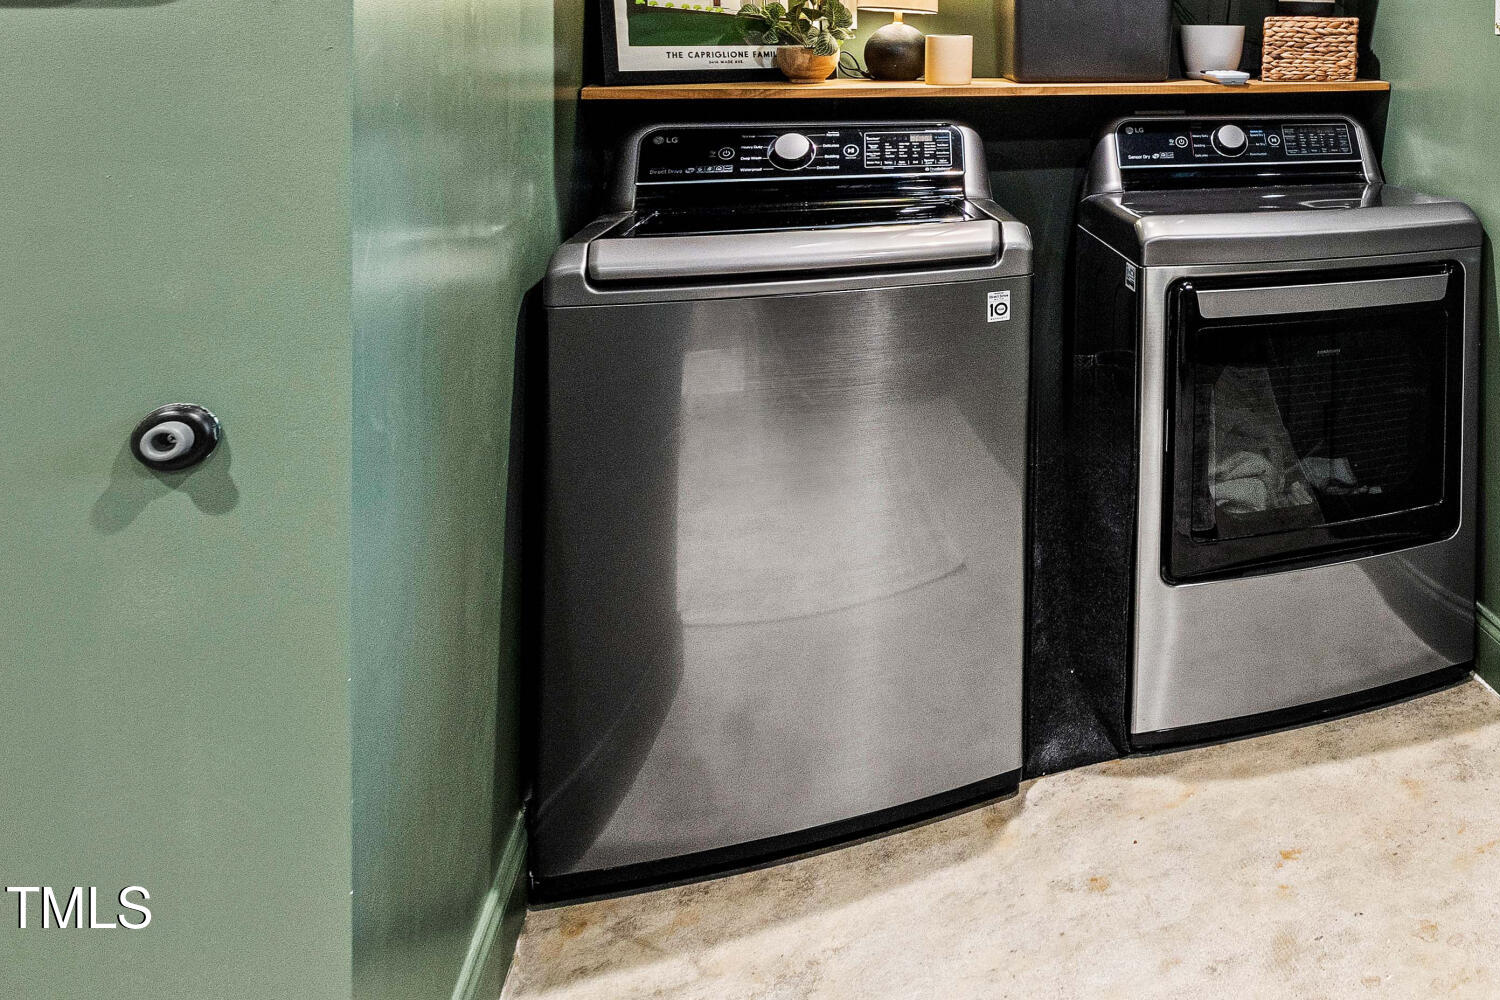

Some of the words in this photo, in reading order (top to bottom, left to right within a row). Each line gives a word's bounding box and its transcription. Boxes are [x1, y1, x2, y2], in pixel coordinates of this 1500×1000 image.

[665, 51, 683, 59] THE
[687, 50, 749, 59] CAPRIGLIONE
[752, 50, 778, 58] FAMIL
[666, 136, 678, 144] LG
[989, 302, 1008, 317] 10
